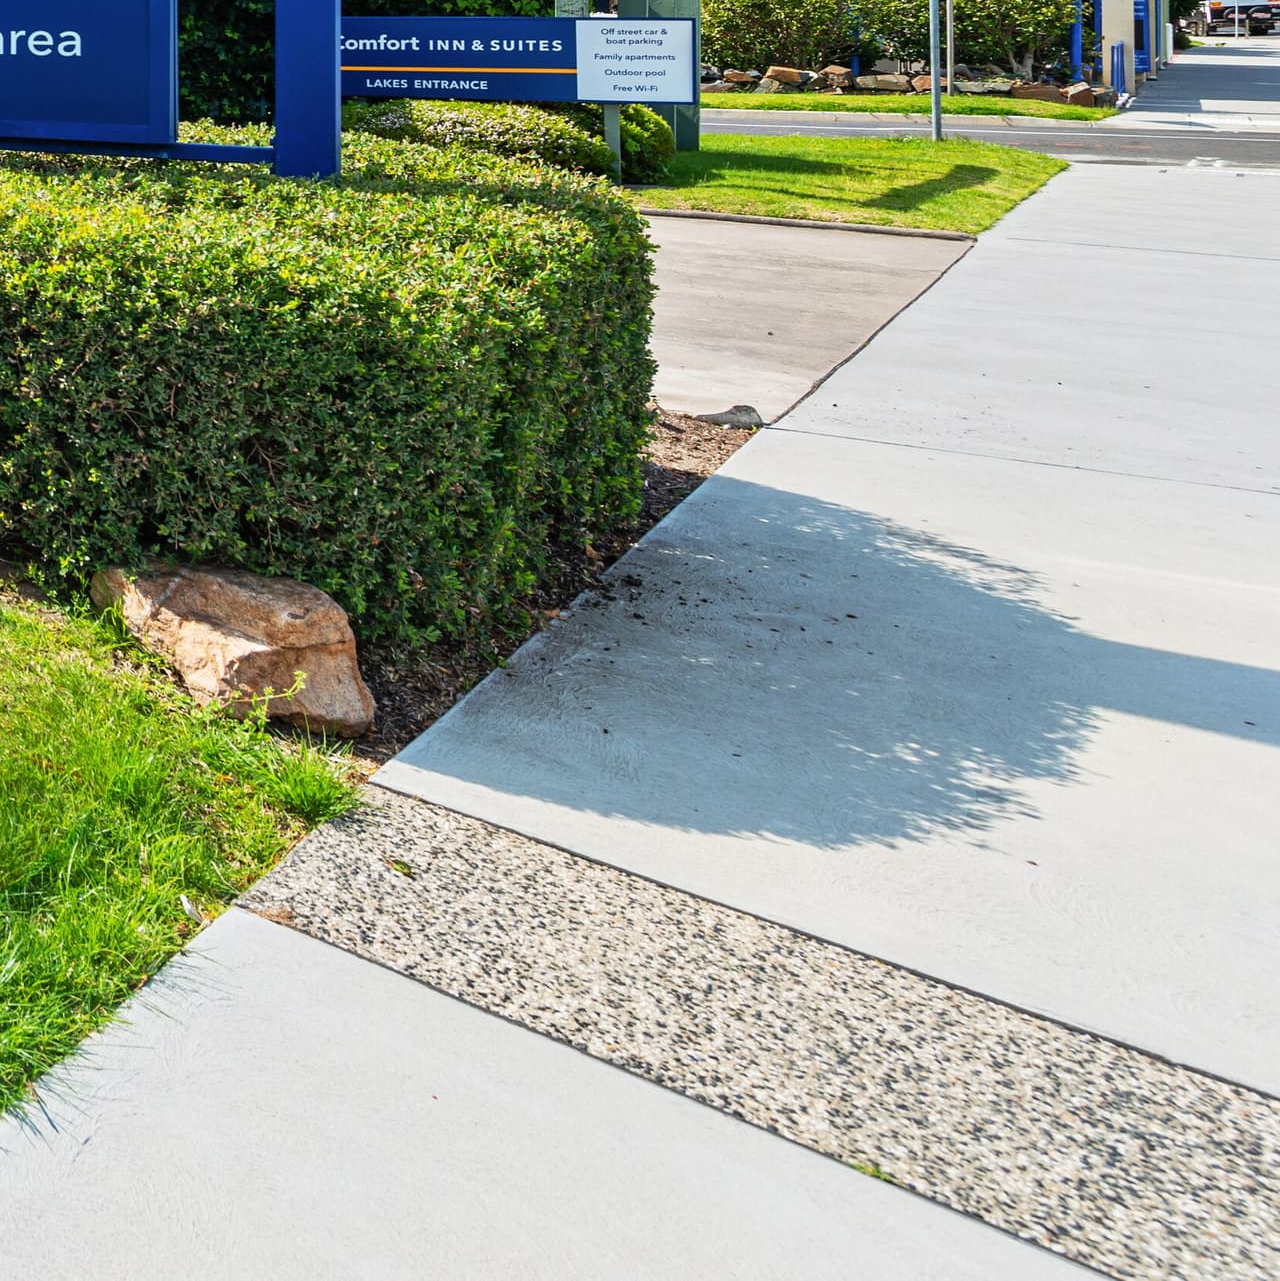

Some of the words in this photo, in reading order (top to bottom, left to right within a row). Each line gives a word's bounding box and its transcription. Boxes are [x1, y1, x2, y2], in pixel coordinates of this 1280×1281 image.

[660, 28, 668, 36] &
[339, 34, 420, 51] omfort
[429, 39, 466, 51] INN
[471, 40, 485, 51] &
[490, 39, 563, 52] SUITES
[628, 38, 663, 46] parking
[594, 53, 622, 61] Family
[645, 69, 666, 77] pool
[366, 78, 408, 89] LAKES
[414, 79, 489, 90] ENTRANCE
[613, 84, 633, 92] Free
